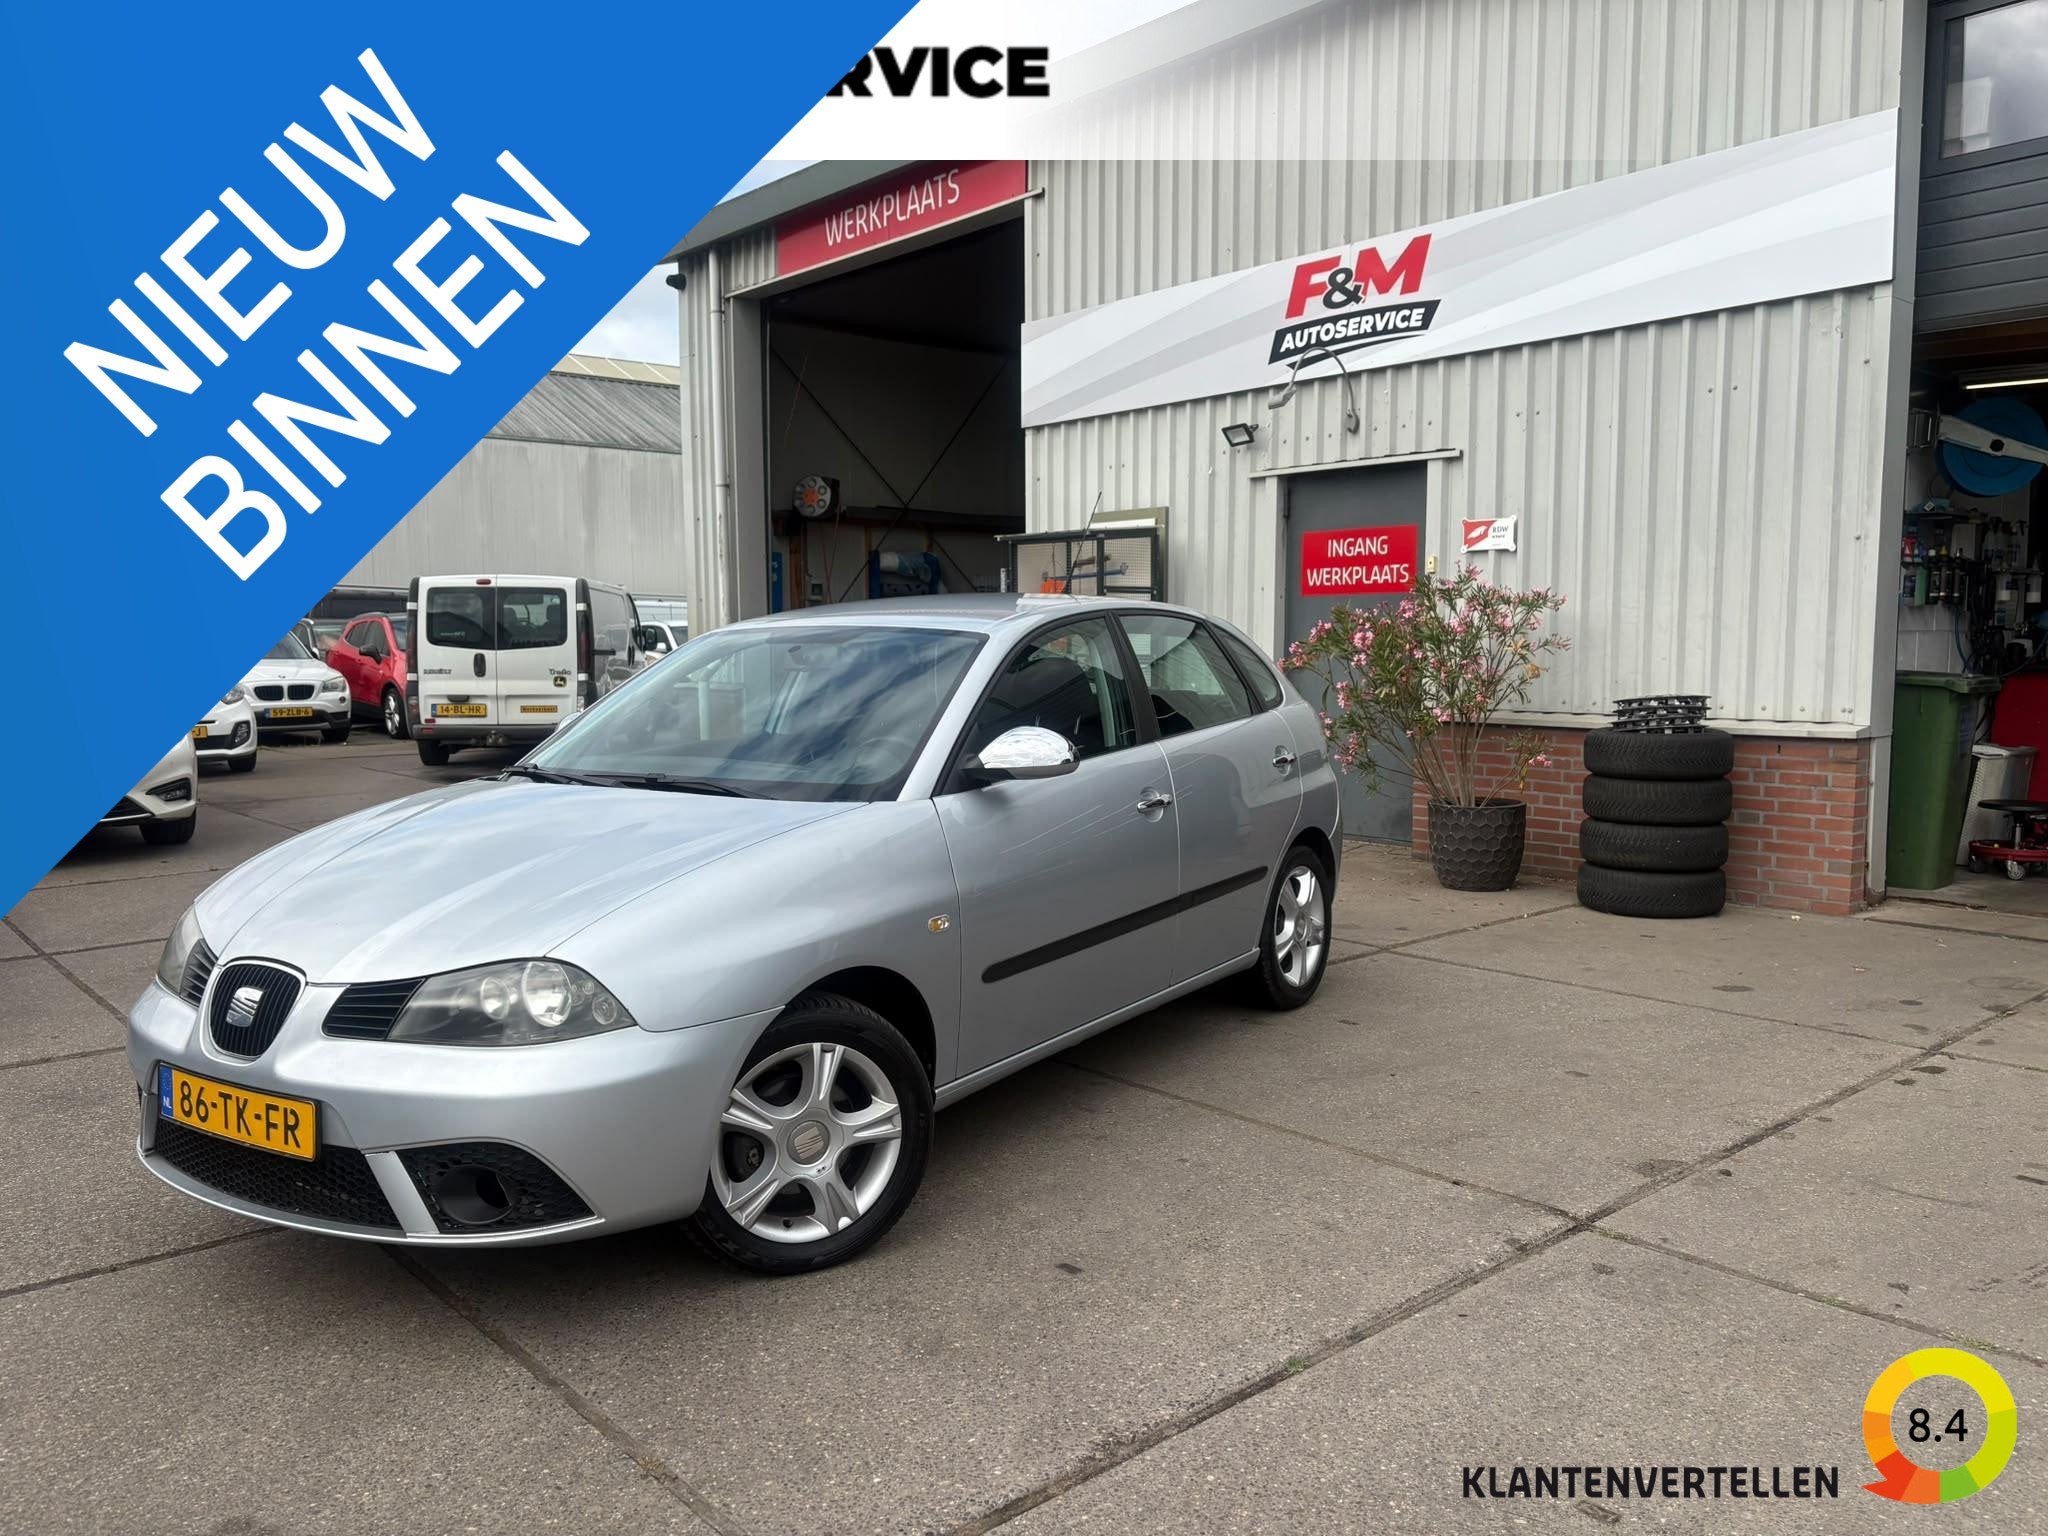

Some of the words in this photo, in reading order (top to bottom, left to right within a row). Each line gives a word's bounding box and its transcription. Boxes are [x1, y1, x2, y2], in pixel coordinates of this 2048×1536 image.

[825, 168, 961, 246] WERKPLAATS
[1285, 233, 1432, 319] F&M
[1279, 307, 1426, 353] AUTOSERVICE
[1327, 535, 1389, 558] INGANG
[1306, 563, 1410, 587] WERKPLAATS
[439, 705, 481, 715] 14-BL-HR
[179, 1080, 301, 1148] 86-TK-FR
